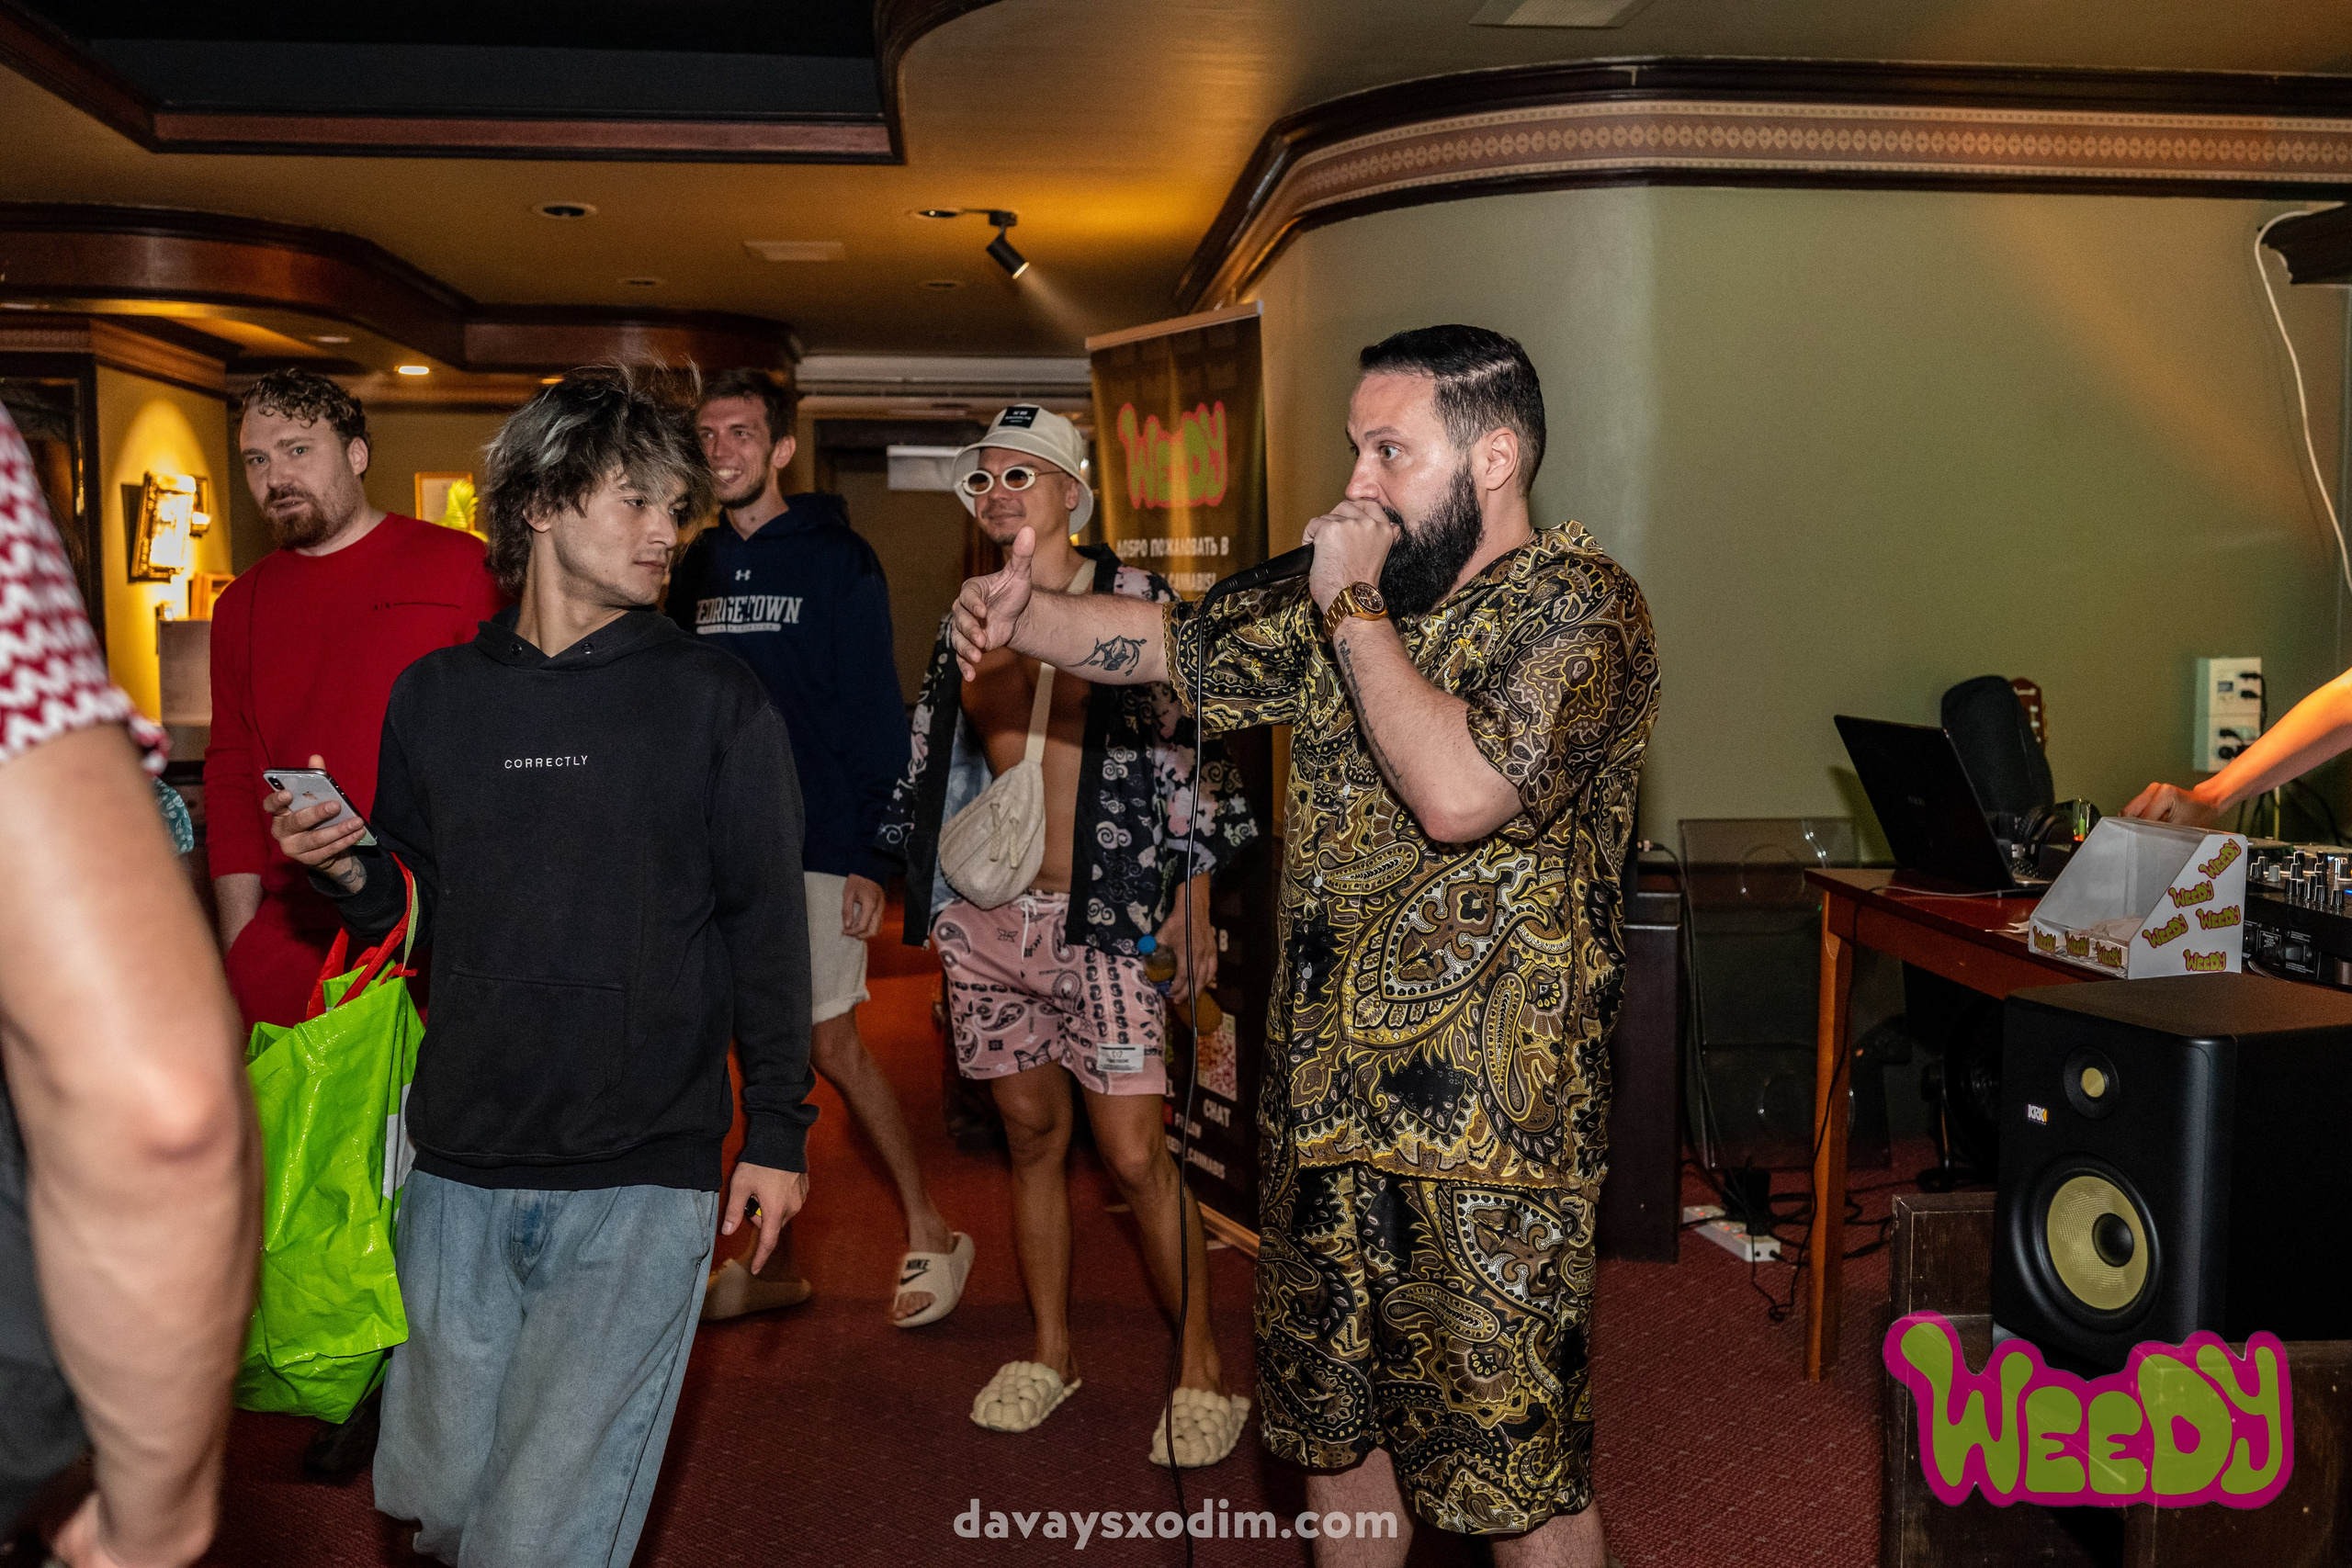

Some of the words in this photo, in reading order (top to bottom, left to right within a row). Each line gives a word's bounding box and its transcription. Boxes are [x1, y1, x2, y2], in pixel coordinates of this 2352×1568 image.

[695, 594, 804, 625] EORGETOWN
[504, 755, 588, 769] CORRECTLY
[2198, 838, 2242, 879] WEEDY
[2167, 880, 2214, 908] WEEDY
[2195, 905, 2241, 930] WEEDY
[2142, 913, 2188, 949] WEEDY
[2183, 949, 2226, 972] WEEDY
[2028, 1103, 2046, 1122] KRK
